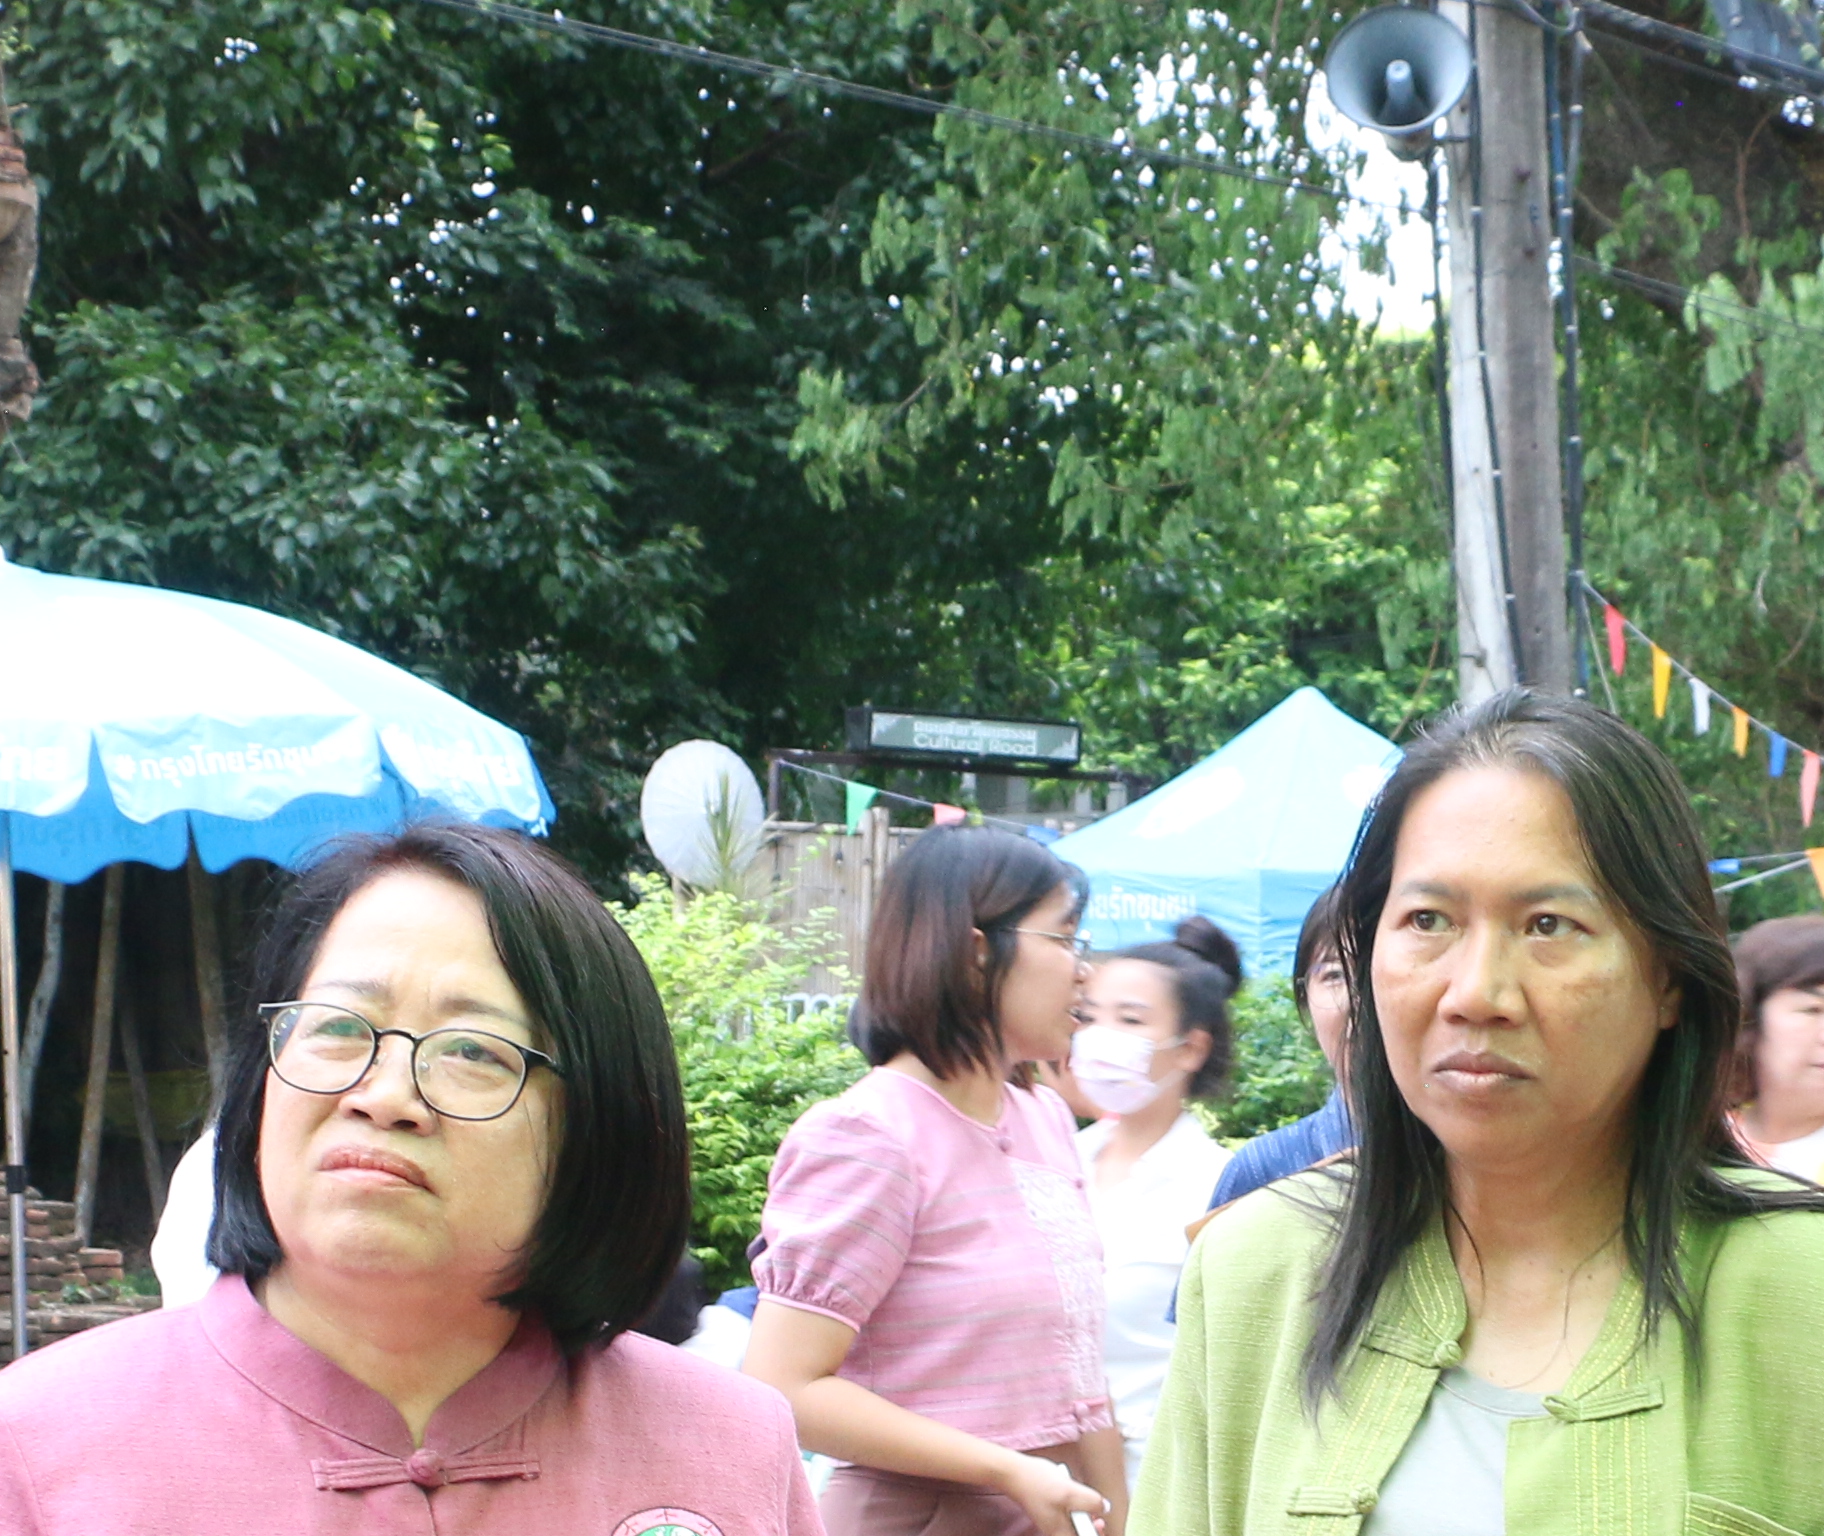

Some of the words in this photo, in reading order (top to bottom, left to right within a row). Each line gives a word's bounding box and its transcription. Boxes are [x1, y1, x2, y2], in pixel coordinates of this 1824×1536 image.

[113, 734, 364, 789] #กรุงไทยรักชุม
[913, 733, 983, 752] Cultural
[988, 739, 1037, 756] Road
